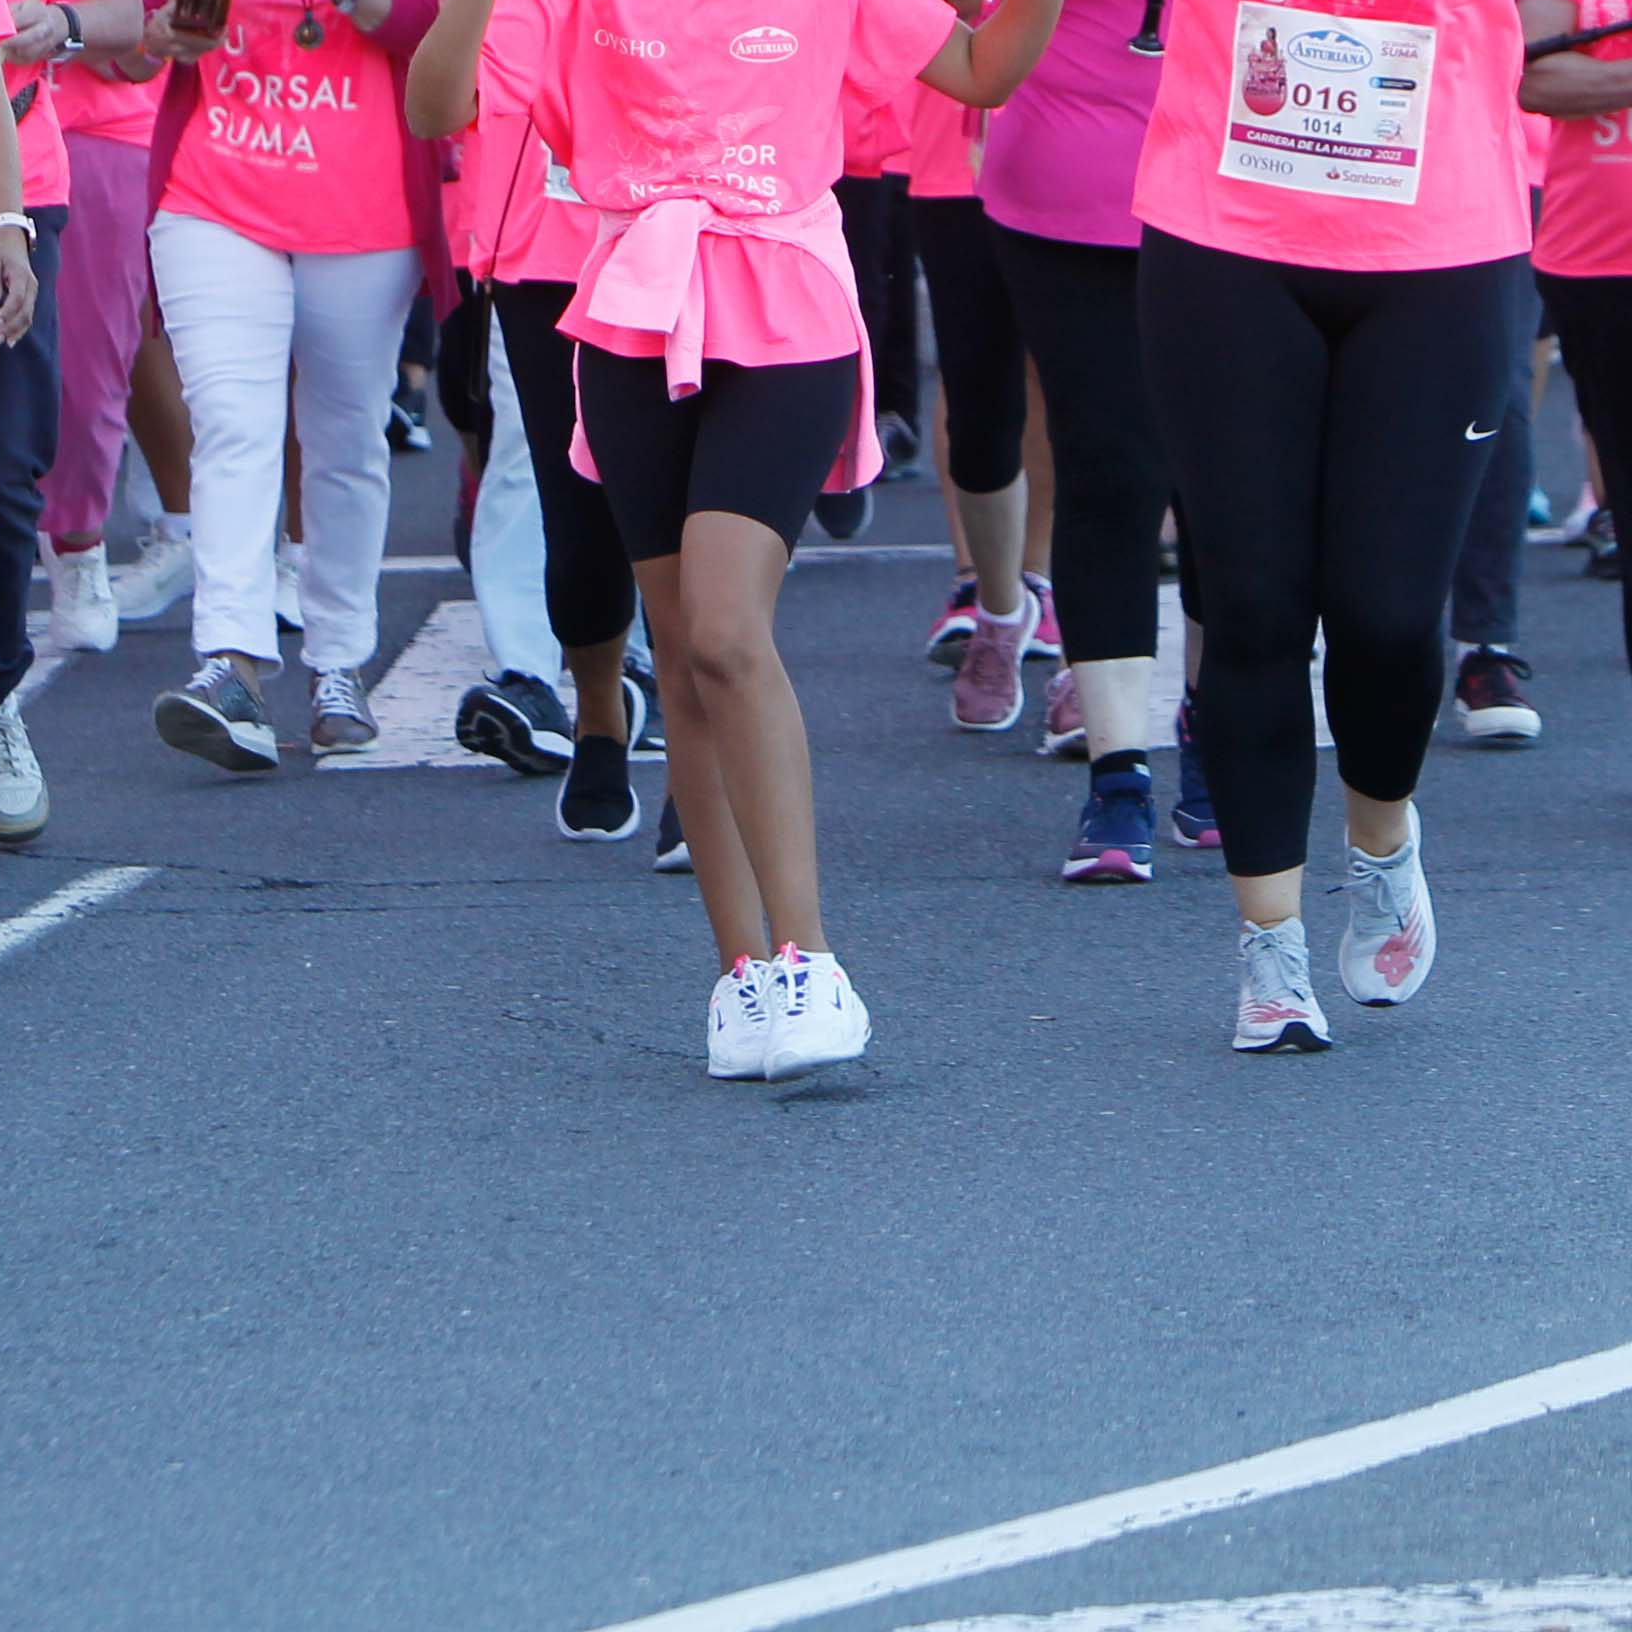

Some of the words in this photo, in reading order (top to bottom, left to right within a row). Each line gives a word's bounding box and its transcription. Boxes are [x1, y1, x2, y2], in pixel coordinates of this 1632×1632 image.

[593, 28, 666, 60] OYSHO
[734, 40, 794, 56] ASTURIANA
[1292, 39, 1366, 66] ASTURIANA
[1292, 82, 1358, 114] 016
[208, 105, 316, 159] SUMA
[1302, 117, 1343, 137] 1014
[720, 144, 777, 166] POR
[1246, 128, 1296, 148] CARRERA
[1297, 139, 1313, 152] DE
[1316, 141, 1331, 154] LA
[1332, 144, 1373, 159] MUJER
[1239, 152, 1294, 176] OYSHO
[1342, 169, 1404, 188] Santander
